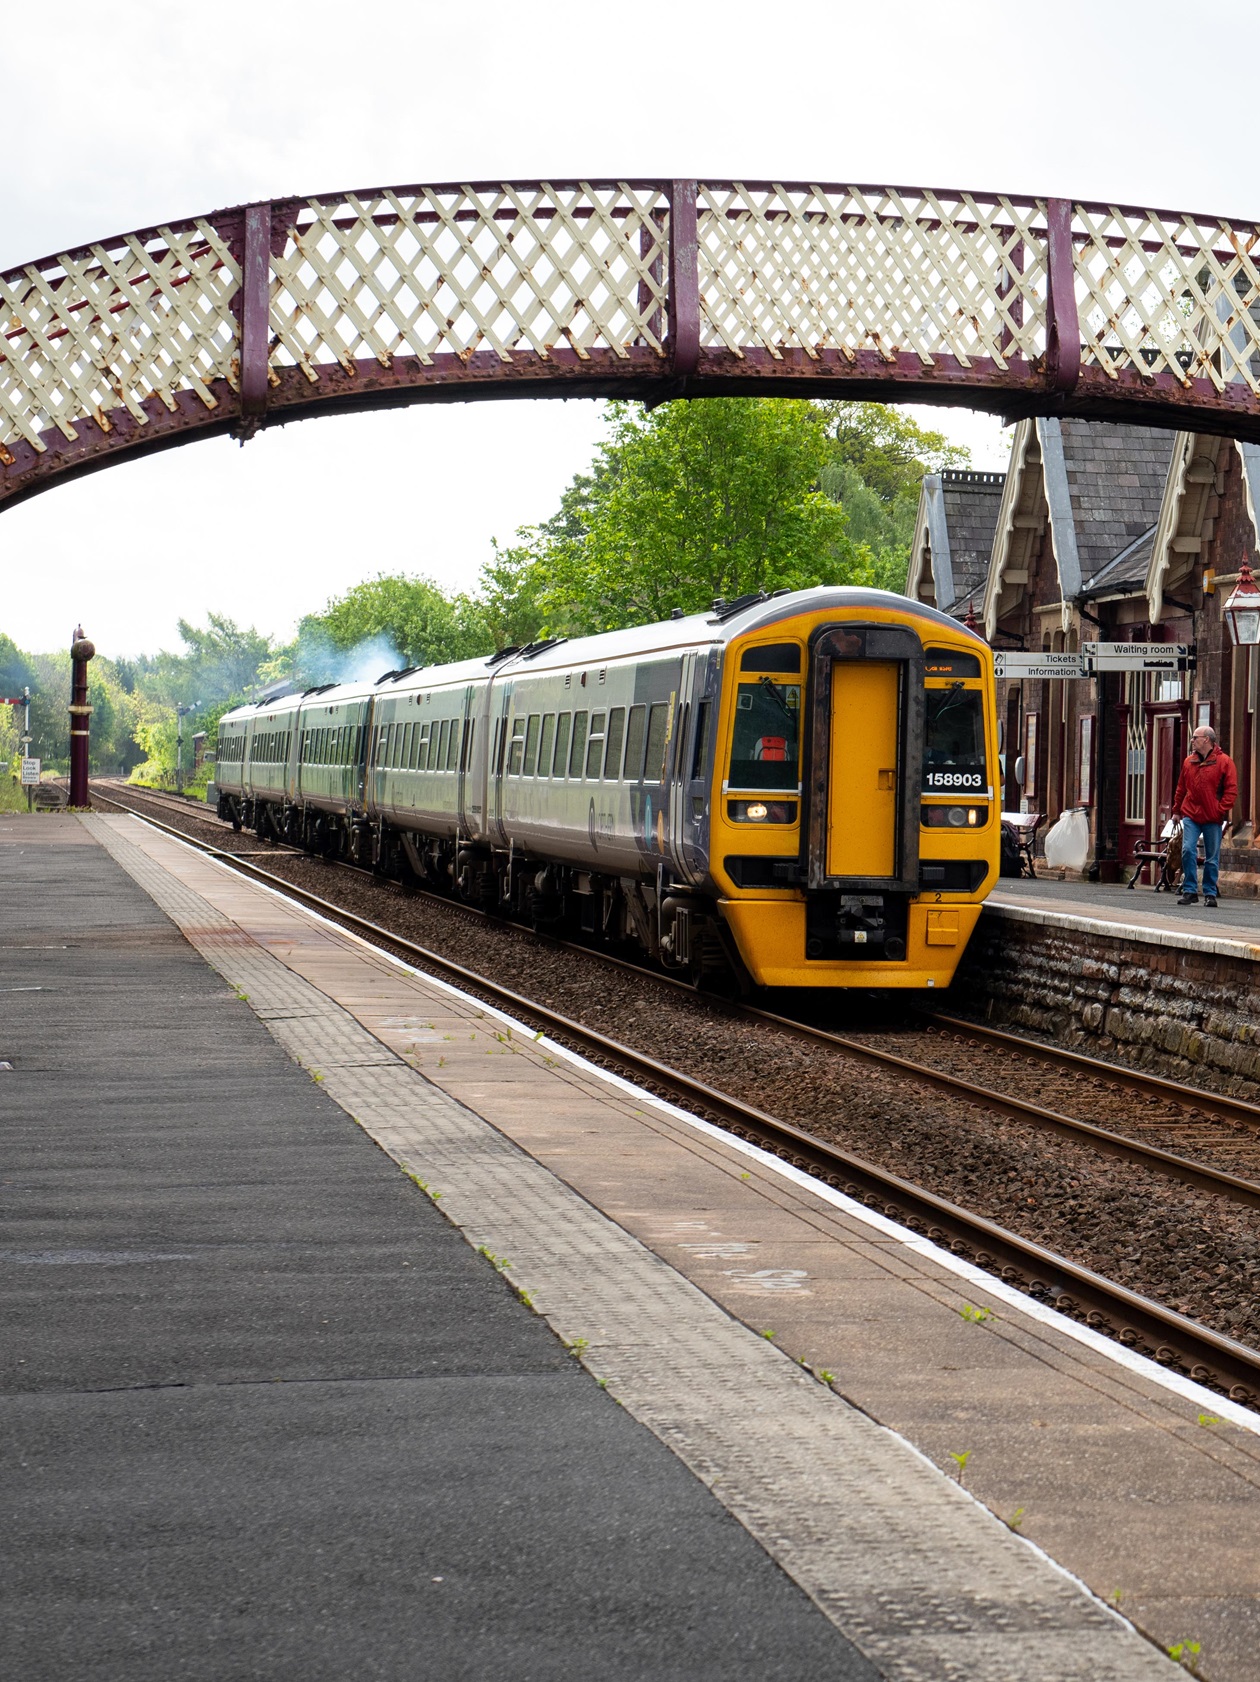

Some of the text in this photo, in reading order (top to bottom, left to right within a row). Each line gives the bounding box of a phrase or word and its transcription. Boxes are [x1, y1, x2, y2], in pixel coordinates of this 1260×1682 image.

[1114, 645, 1147, 655] Waiting
[926, 773, 982, 787] 158903
[934, 892, 942, 902] 2
